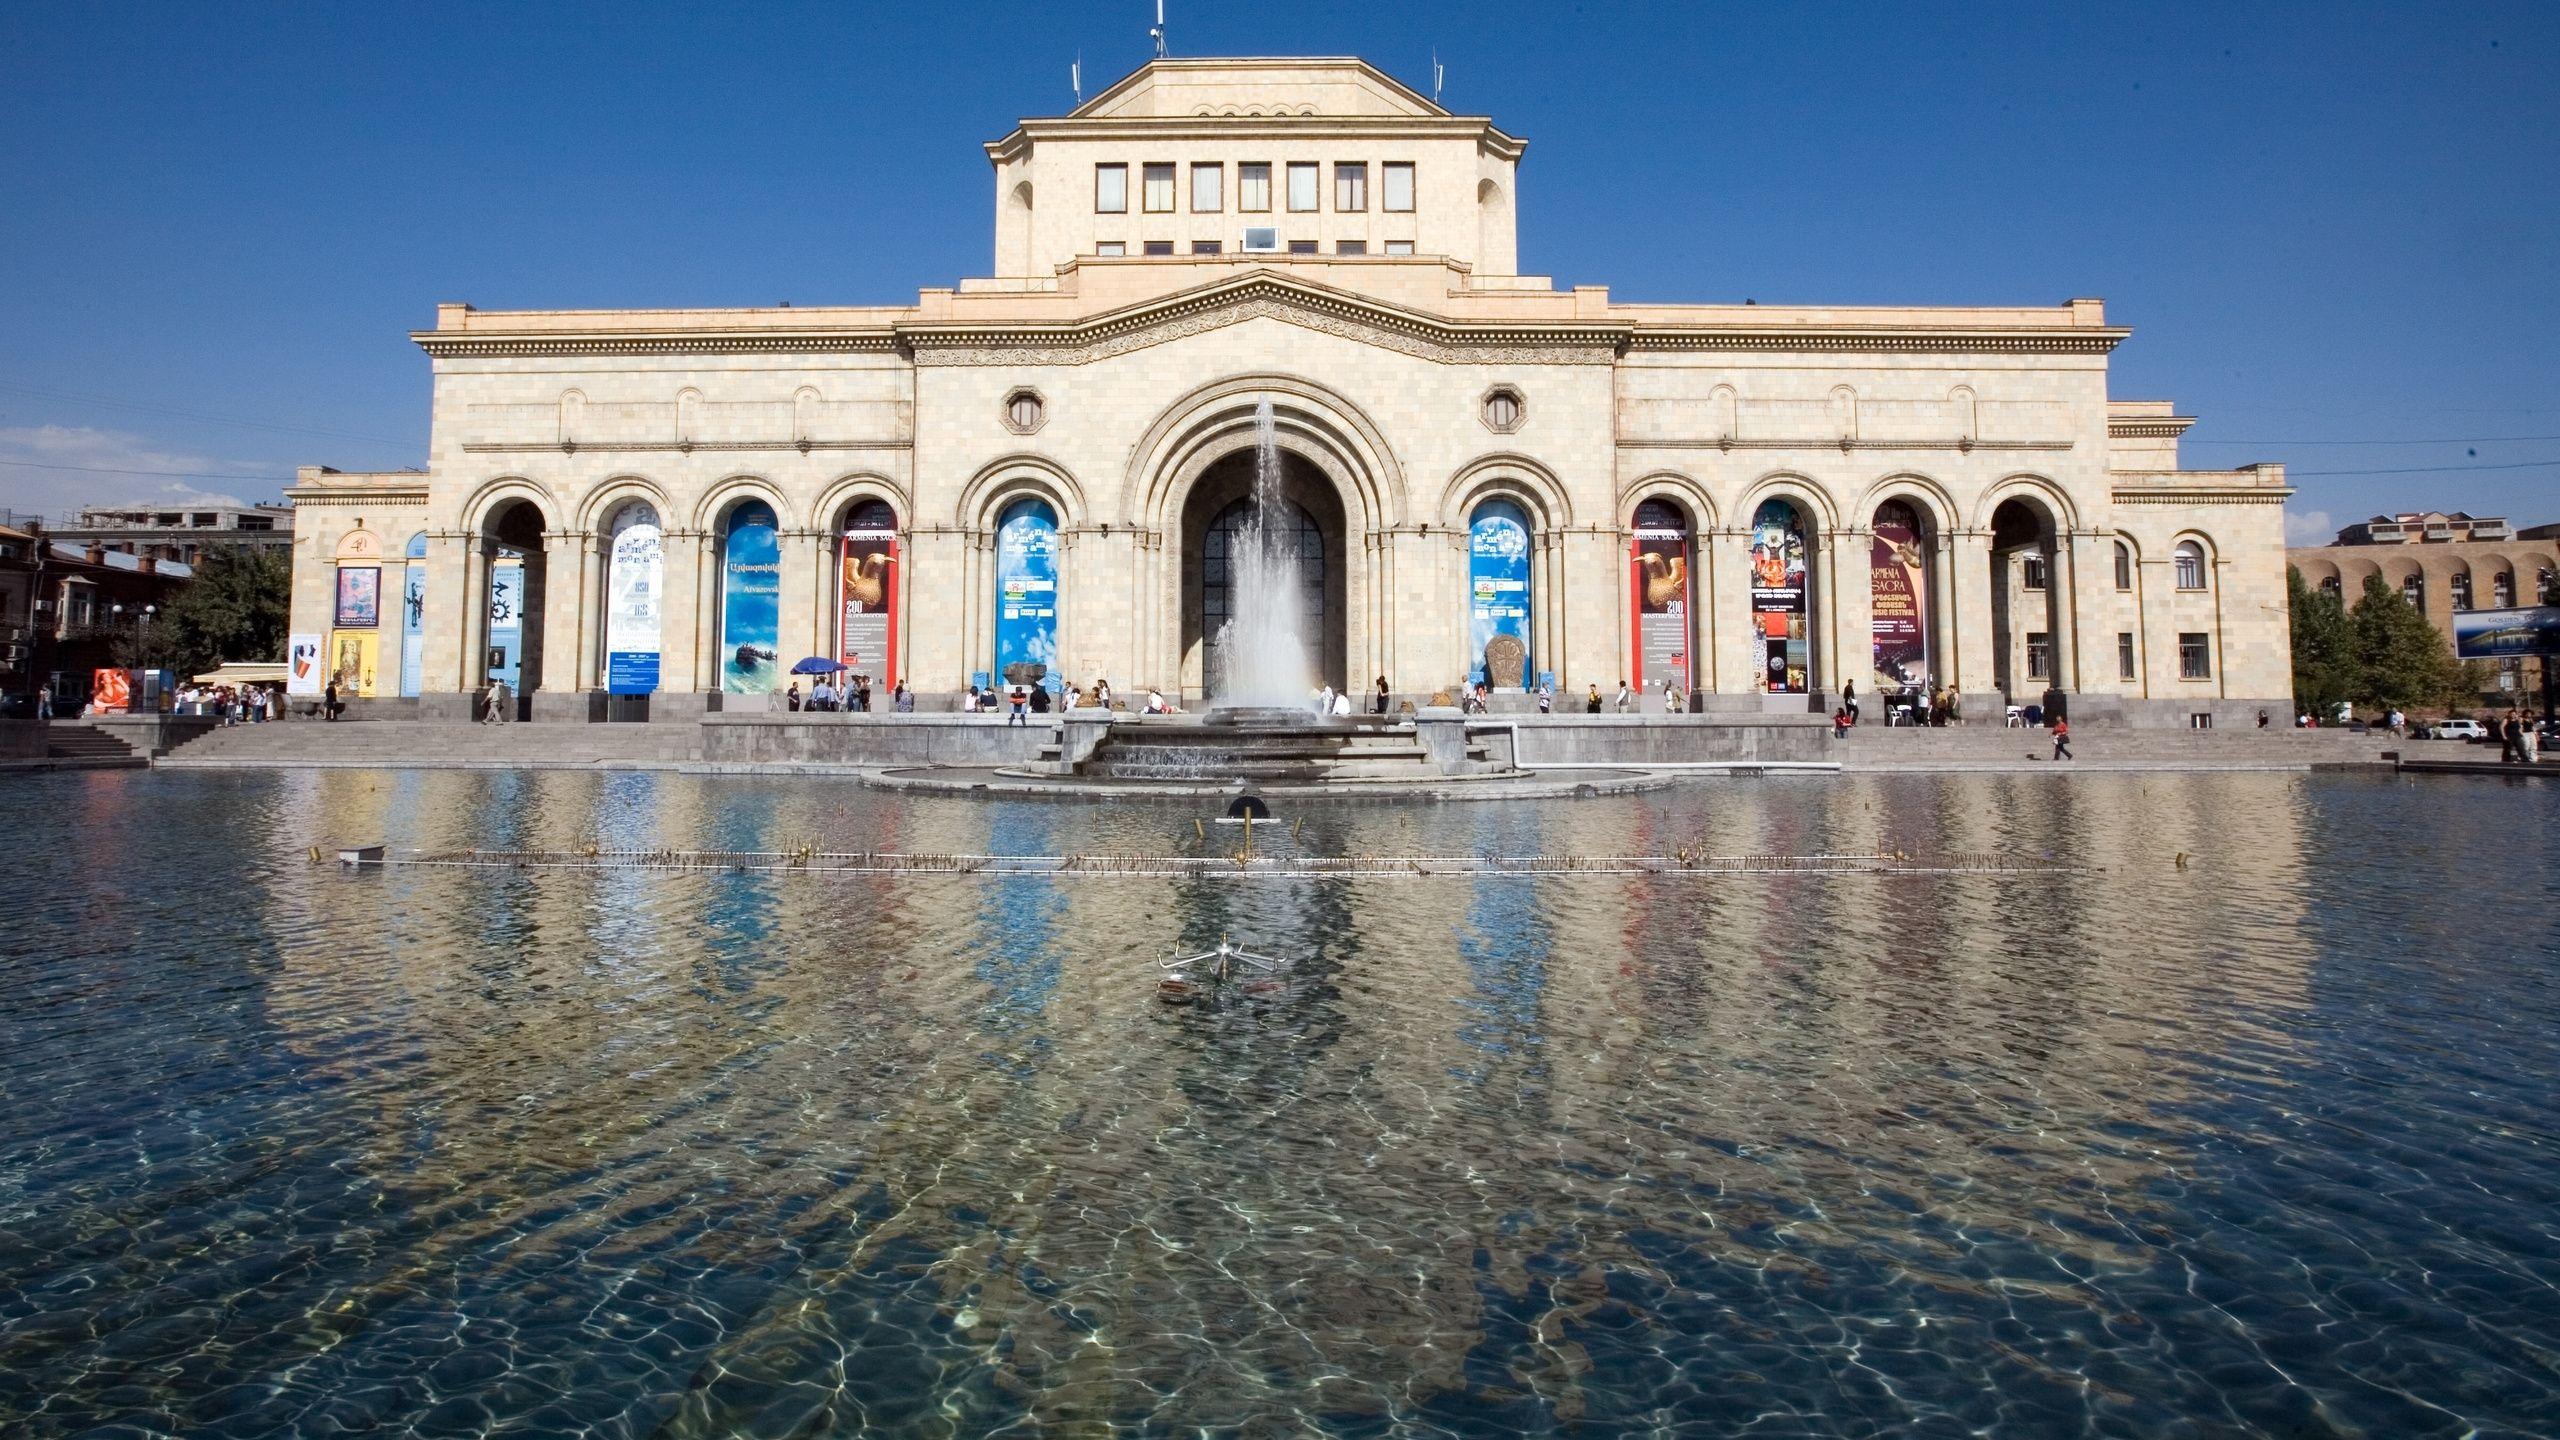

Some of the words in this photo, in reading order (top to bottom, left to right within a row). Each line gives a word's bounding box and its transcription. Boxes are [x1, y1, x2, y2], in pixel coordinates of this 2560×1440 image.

[1871, 567, 1900, 579] ARMENIA
[1872, 580, 1906, 592] SACRA
[846, 600, 863, 614] 200
[1667, 600, 1684, 614] 200
